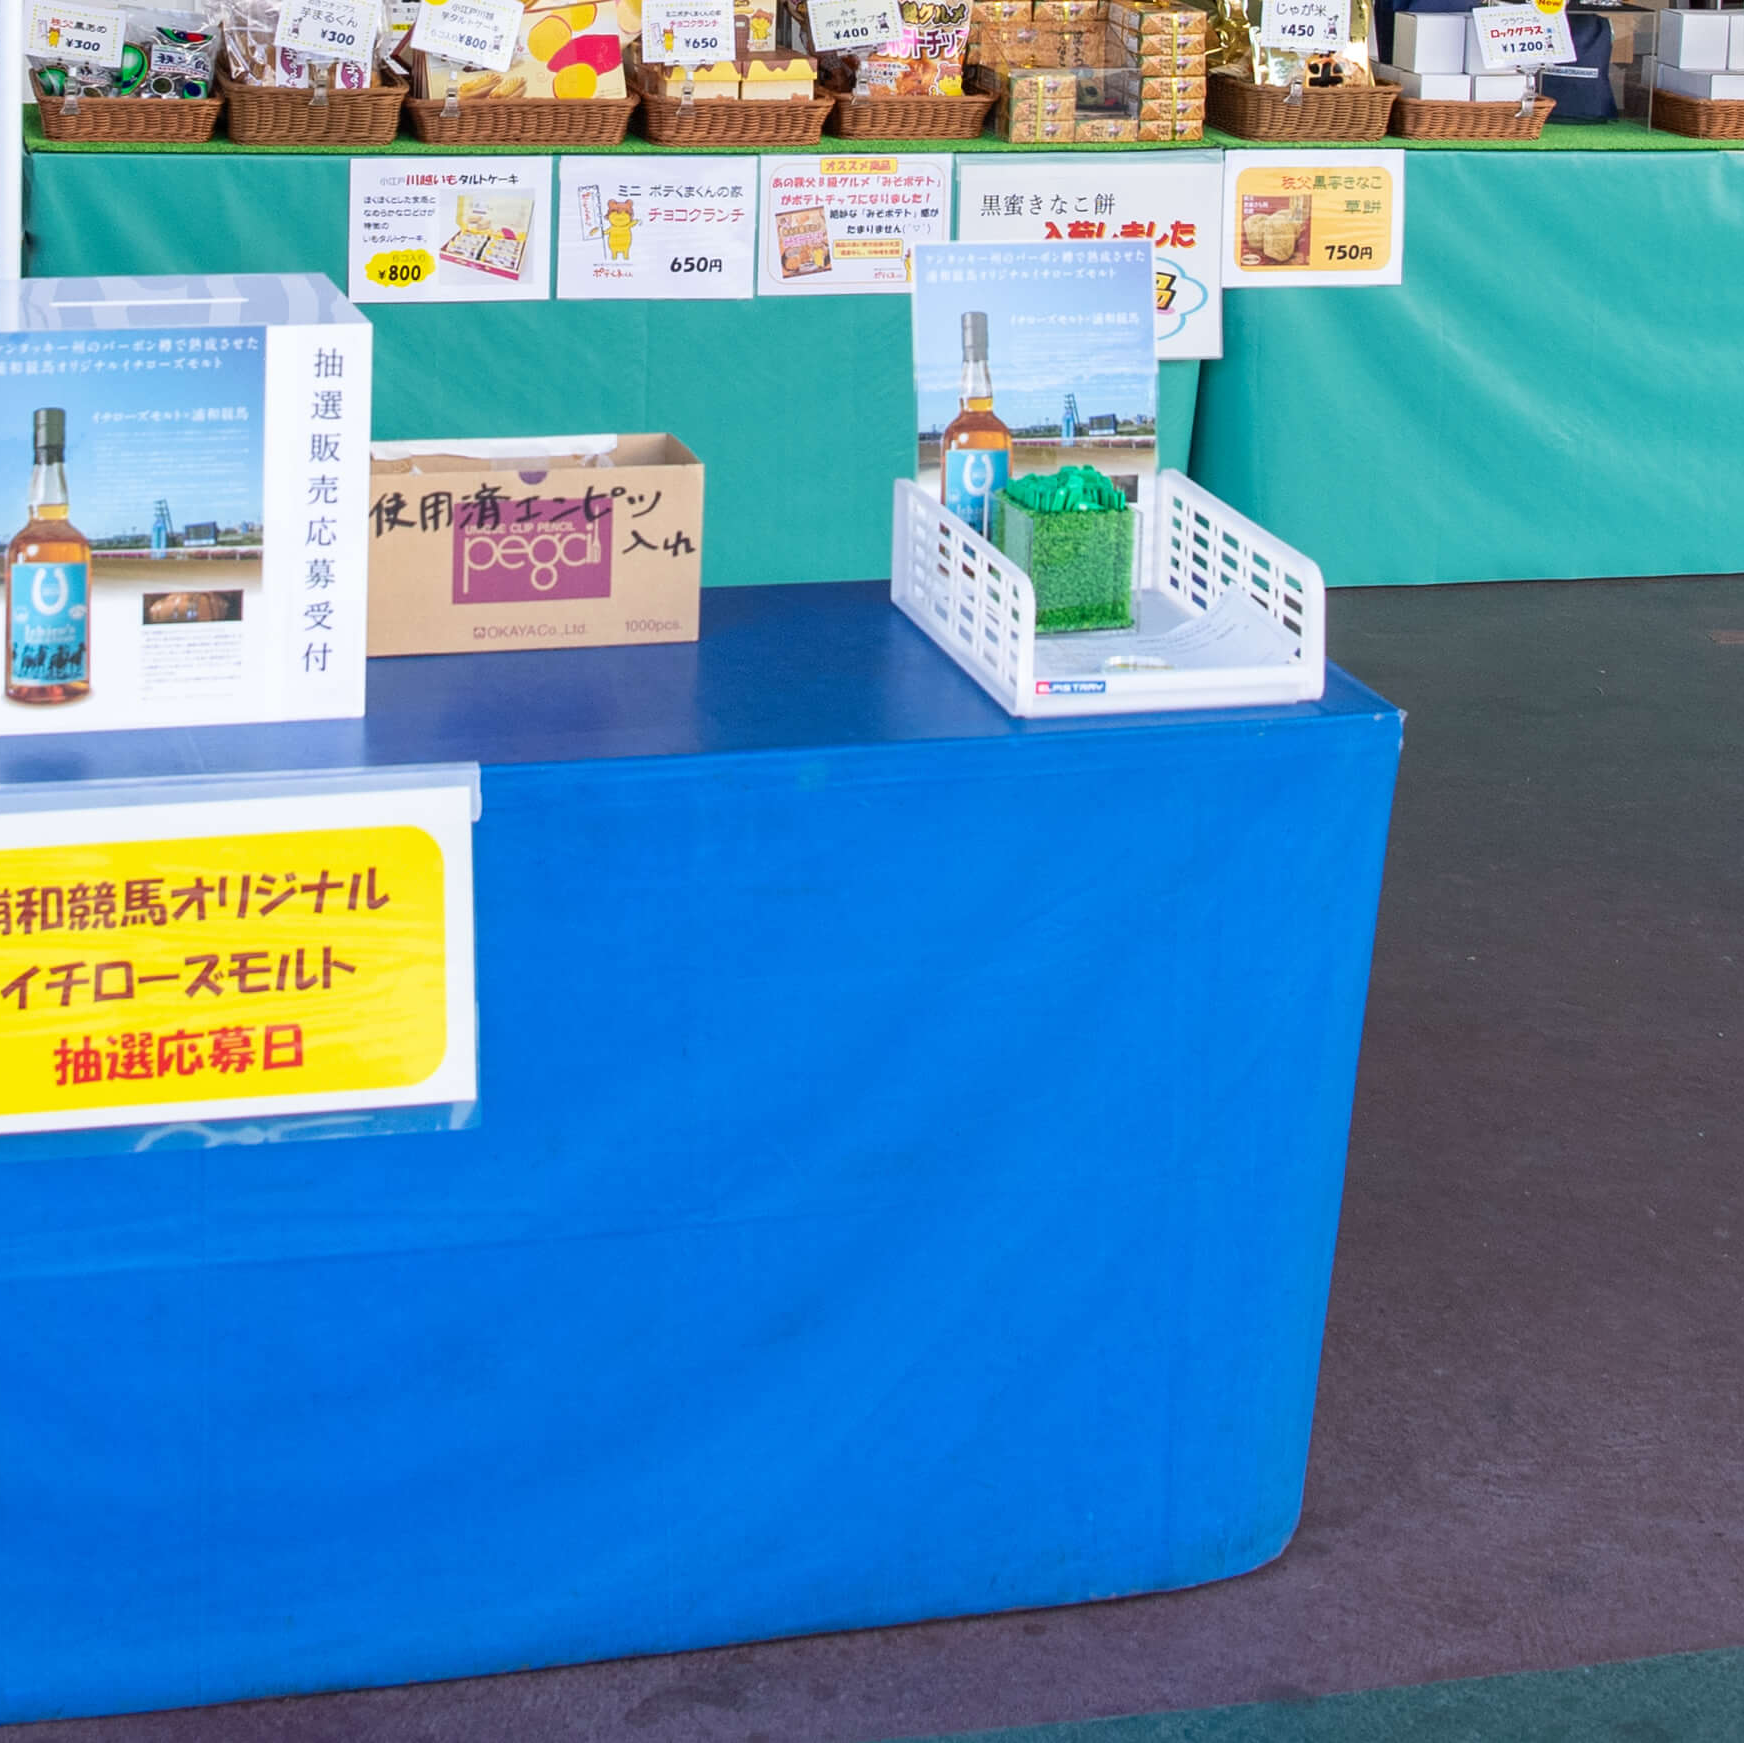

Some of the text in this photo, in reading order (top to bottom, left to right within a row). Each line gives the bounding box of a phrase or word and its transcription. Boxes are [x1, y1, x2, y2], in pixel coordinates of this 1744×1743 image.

[301, 7, 359, 29] 芋まるくん
[1276, 2, 1328, 18] じゃが米
[669, 20, 719, 28] チョコクランチ
[1281, 24, 1315, 38] ¥450
[1490, 25, 1544, 39] ロックグラス
[320, 29, 355, 46] ¥300
[834, 27, 869, 40] ¥400
[65, 37, 101, 52] ¥300
[684, 37, 719, 49] ¥650
[618, 184, 642, 197] ミニ
[981, 193, 1116, 216] 黒蜜きなこ餅
[648, 208, 745, 222] チョコクランチ
[1325, 244, 1373, 261] 750円
[378, 264, 422, 281] ¥800
[670, 256, 722, 273] 650円
[302, 347, 345, 674] 抽選販売応募受付
[509, 522, 534, 535] CLIP
[537, 520, 577, 534] PENCIL
[622, 529, 696, 557] 入れ
[0, 947, 357, 1010] イチローズモルト
[53, 1023, 304, 1087] 抽選応募日
